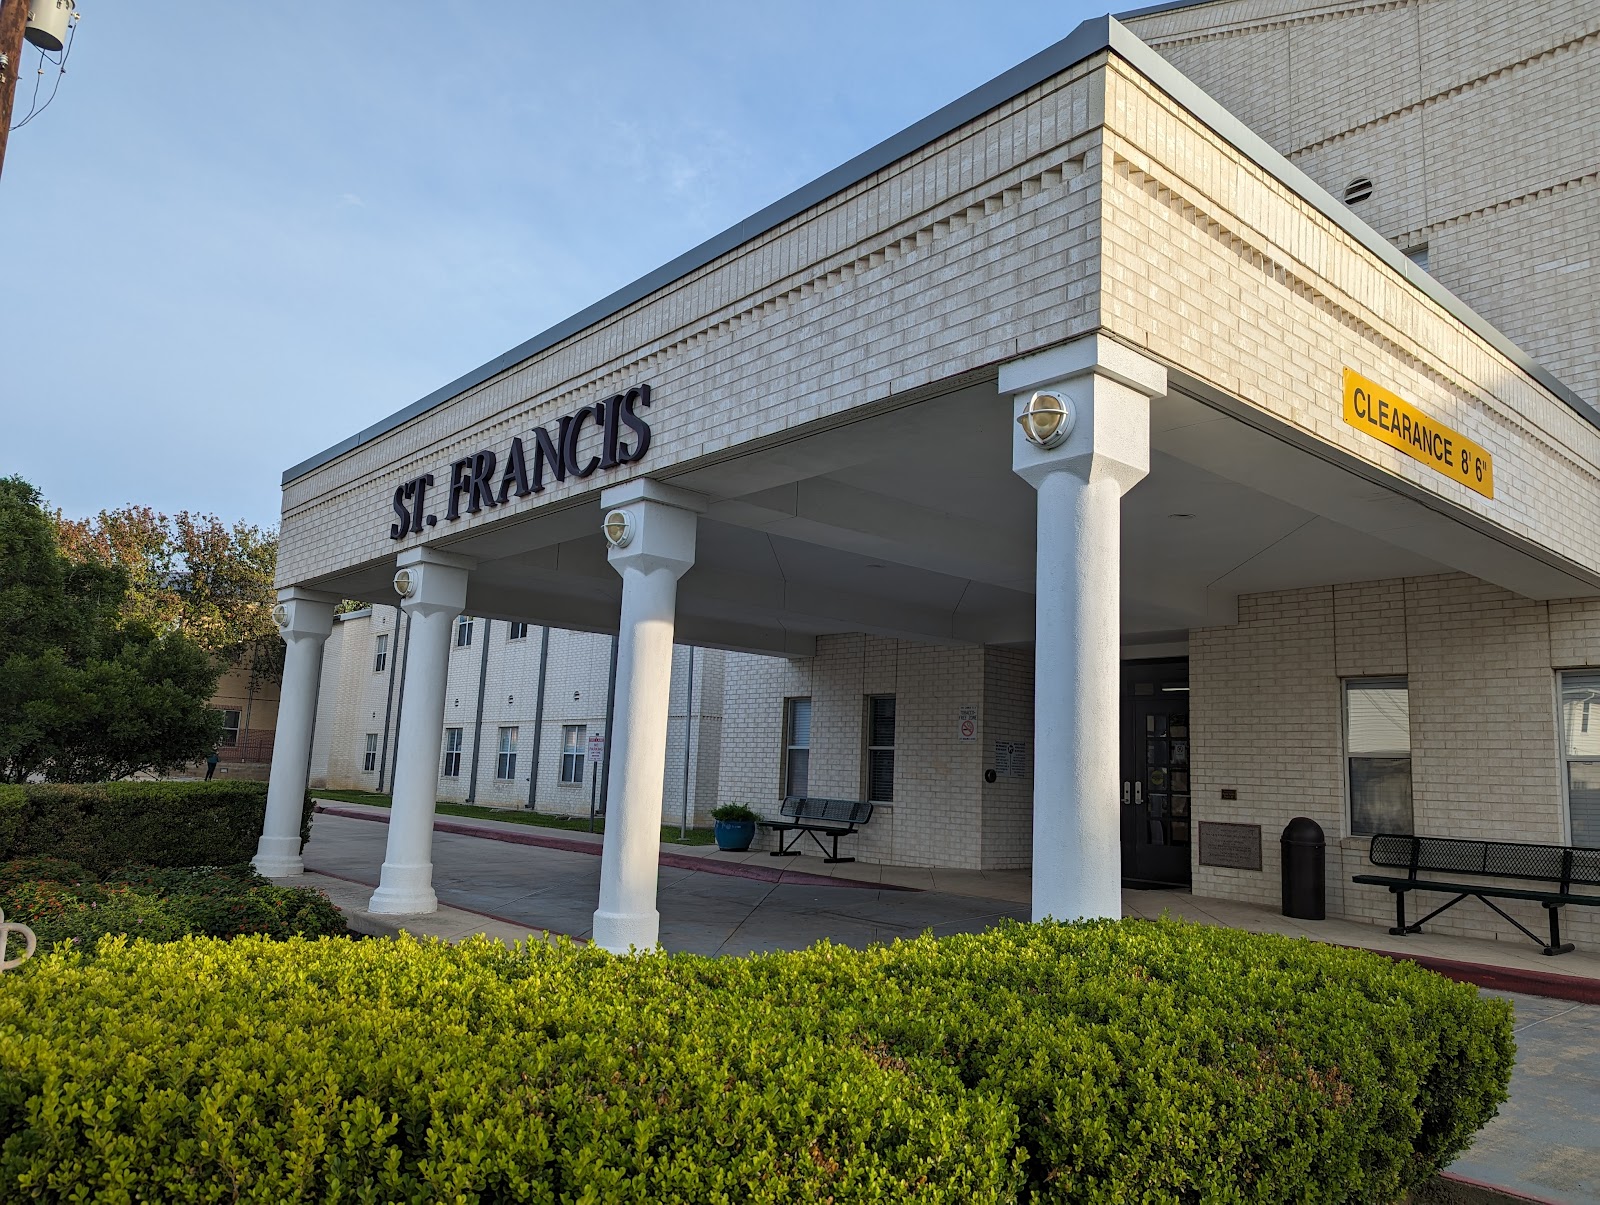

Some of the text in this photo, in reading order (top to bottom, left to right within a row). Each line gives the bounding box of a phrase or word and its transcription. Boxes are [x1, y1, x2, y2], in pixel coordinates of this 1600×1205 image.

[390, 383, 651, 540] ST. FRANCIS
[1353, 387, 1454, 467] CLEARANCE
